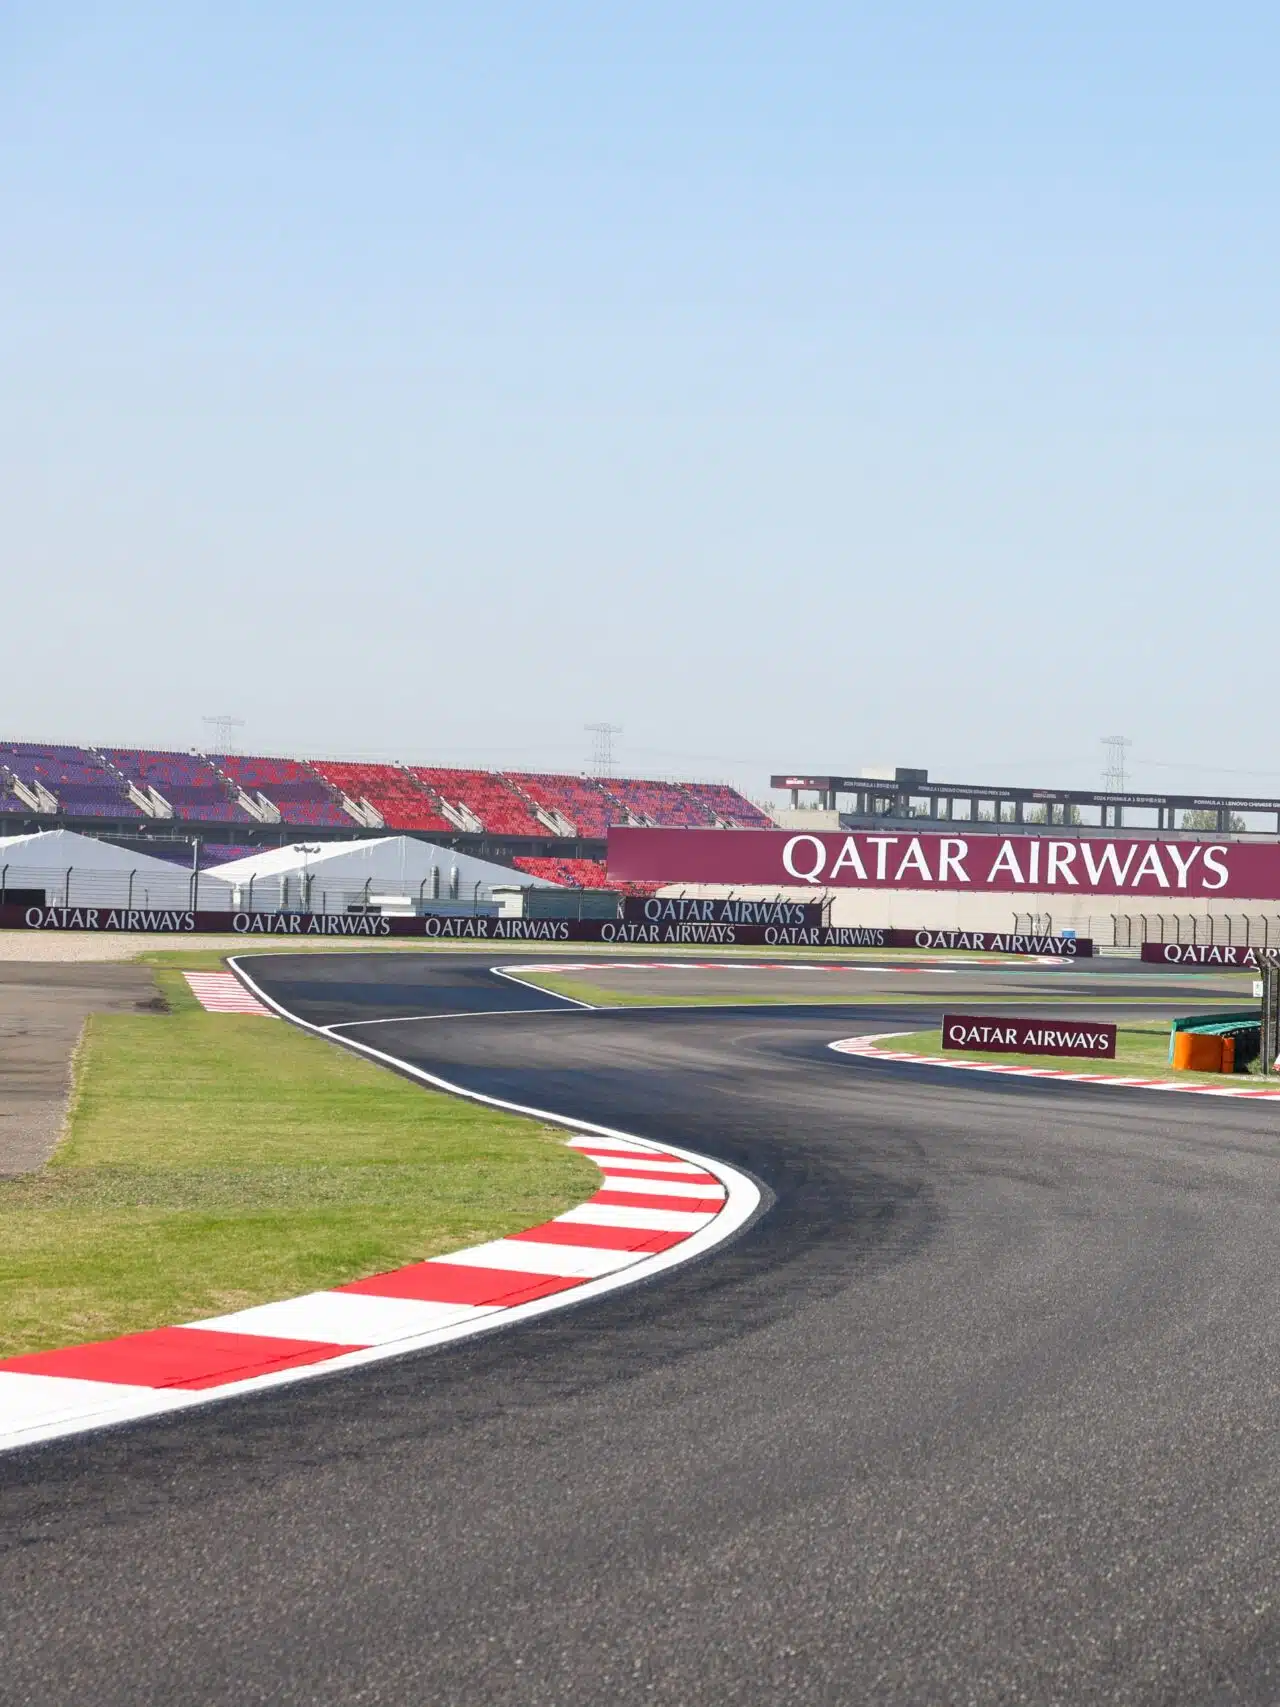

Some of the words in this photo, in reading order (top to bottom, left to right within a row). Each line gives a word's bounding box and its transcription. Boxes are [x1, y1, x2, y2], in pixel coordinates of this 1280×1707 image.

[782, 834, 971, 884] QATAR
[987, 839, 1229, 889] AIRWAYS
[25, 907, 99, 928] QATAR
[105, 910, 195, 930] AIRWAYS
[644, 898, 714, 922] QATAR
[720, 901, 805, 924] AIRWAYS
[233, 912, 301, 933] QATAR
[307, 915, 390, 935] AIRWAYS
[425, 918, 488, 937] QATAR
[492, 920, 569, 939] AIRWAYS
[601, 923, 660, 942] QATAR
[664, 924, 736, 943] AIRWAYS
[764, 926, 820, 945] QATAR
[824, 927, 884, 946] AIRWAYS
[915, 929, 985, 950] QATAR
[990, 933, 1077, 954] AIRWAYS
[1163, 944, 1238, 964] QATAR
[949, 1025, 1018, 1045] QATAR
[1022, 1029, 1109, 1050] AIRWAYS
